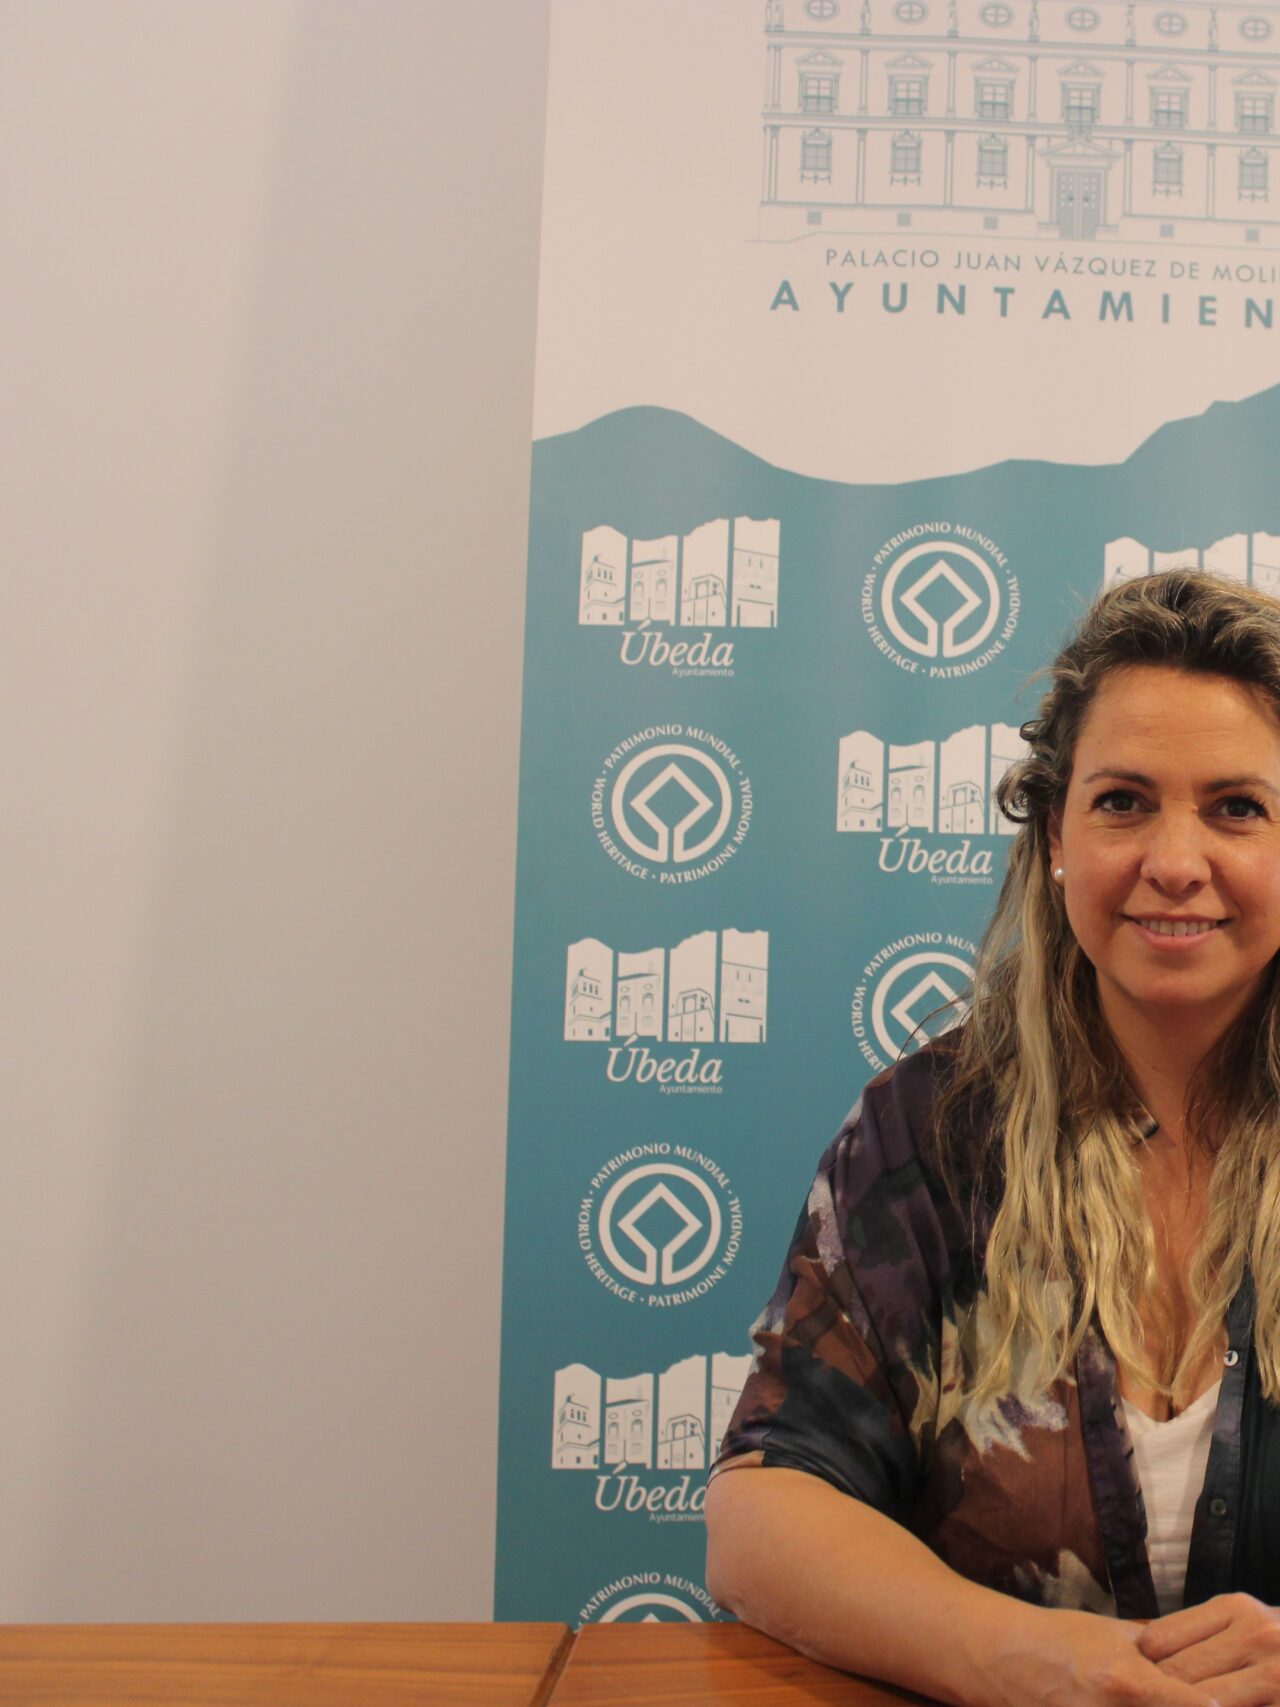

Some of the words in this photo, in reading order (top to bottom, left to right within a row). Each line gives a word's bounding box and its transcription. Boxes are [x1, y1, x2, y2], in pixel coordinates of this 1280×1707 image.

[826, 249, 941, 268] PALACIO
[953, 253, 1021, 272] JUAN
[1035, 252, 1157, 278] VÁZQUEZ
[1170, 262, 1200, 280] DE
[874, 522, 950, 565] PATRIMONIO
[954, 524, 1008, 567] MUNDIAL
[861, 573, 877, 624] WORLD
[619, 618, 734, 667] Úbeda
[867, 625, 919, 673] HERITAGE
[929, 640, 1006, 679] PATRIMOINE
[1001, 576, 1021, 641] MONDIAL
[672, 666, 734, 678] Ayuntamiento
[604, 724, 682, 768] PATRIMONIO
[685, 726, 741, 770] MUNDIAL
[591, 777, 607, 829] WORLD
[659, 843, 737, 884] PATRIMOINE
[732, 777, 753, 844] MONDIAL
[878, 824, 993, 875] Úbeda
[597, 830, 649, 880] HERITAGE
[931, 874, 993, 885] Ayuntamiento
[864, 932, 942, 977] PATRIMONIO
[851, 986, 867, 1038] WORLD
[606, 1034, 723, 1084] Úbeda
[858, 1040, 889, 1073] HERIT
[659, 1084, 723, 1095] Ayuntamiento
[591, 1143, 670, 1189] PATRIMONIO
[673, 1144, 731, 1189] MUNDIAL
[578, 1198, 594, 1250] WORLD
[648, 1265, 727, 1307] PATRIMOINE
[722, 1197, 743, 1266] MONDIAL
[584, 1252, 637, 1303] HERITAGE
[649, 1513, 705, 1524] Ayuntamien
[580, 1572, 661, 1620] PATRIMONIO
[664, 1574, 721, 1618] MUNDIAL
